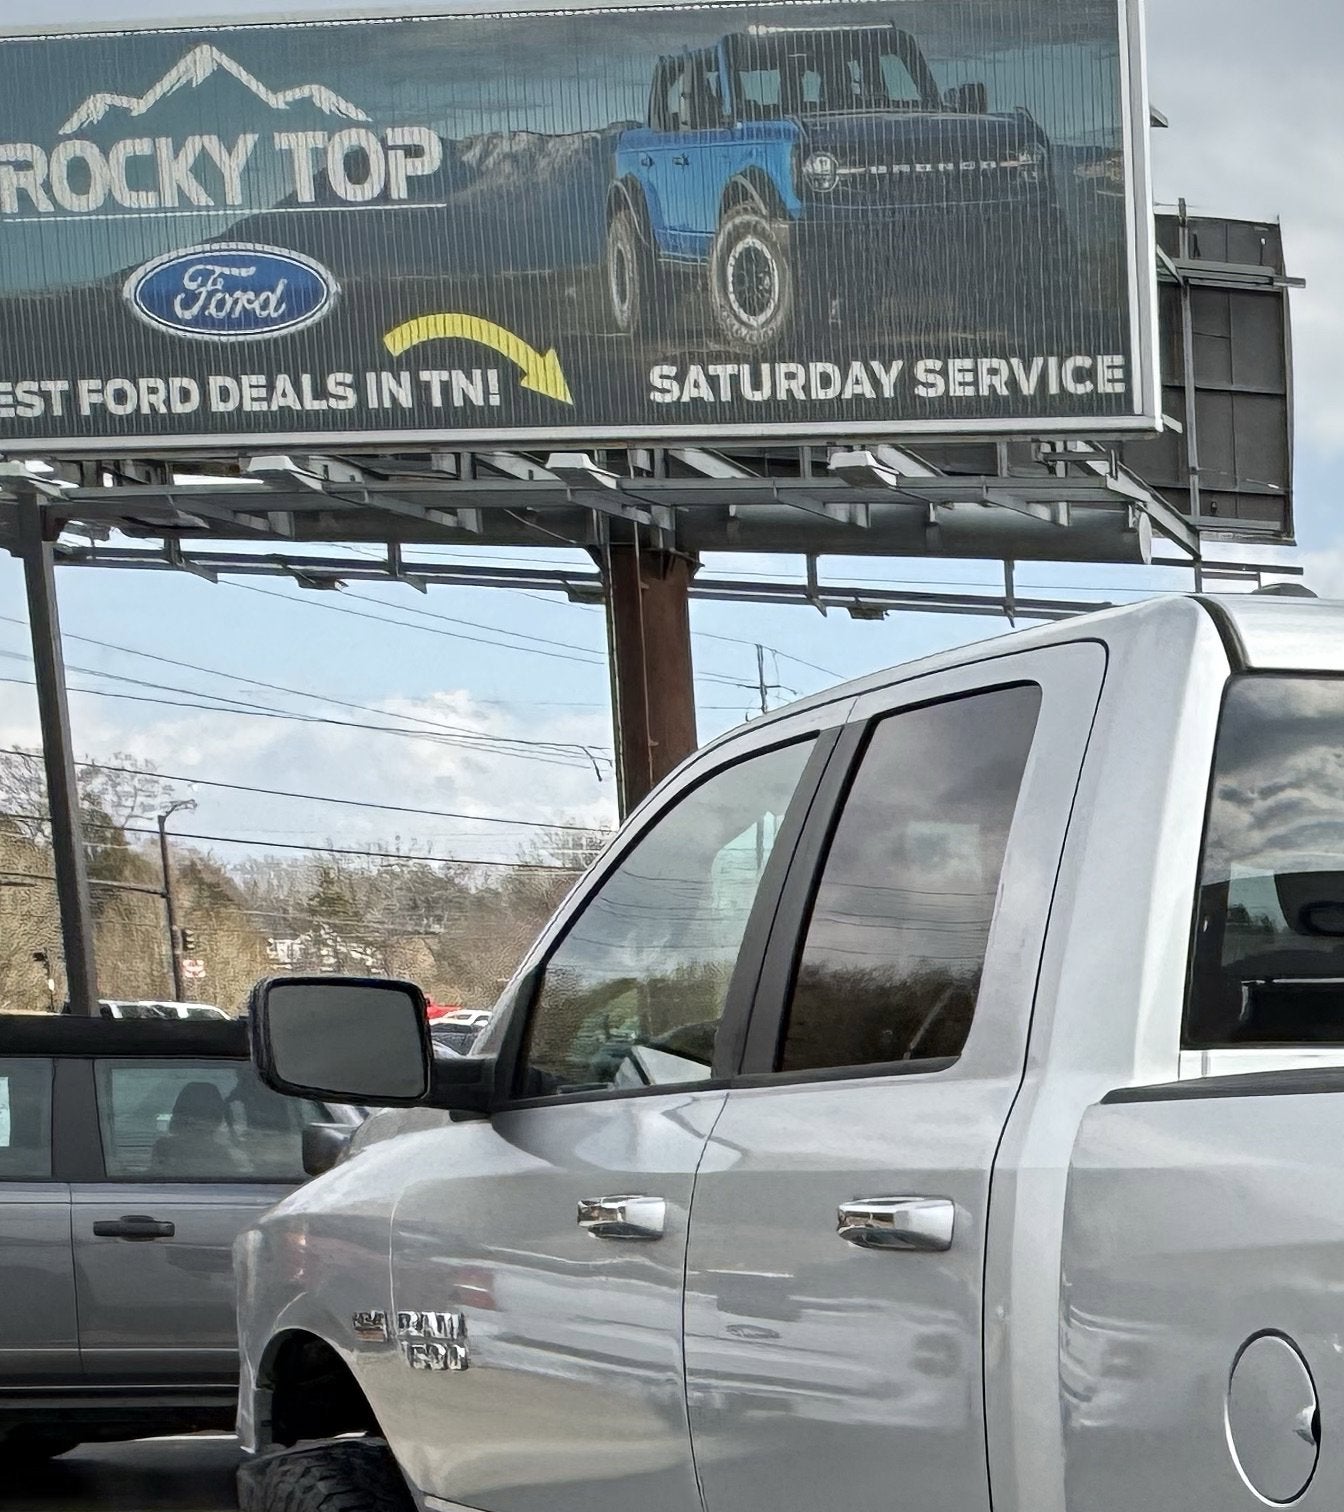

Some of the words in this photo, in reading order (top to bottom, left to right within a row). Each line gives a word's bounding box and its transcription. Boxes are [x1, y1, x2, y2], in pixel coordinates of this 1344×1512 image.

[0, 133, 259, 213] ROCKY
[274, 127, 443, 203] TOP
[173, 264, 288, 319] Ford
[78, 377, 200, 416] FORD
[207, 372, 357, 413] DEALS
[366, 370, 413, 409] IN
[419, 368, 500, 408] TN!
[649, 359, 904, 403] SATURDAY
[914, 355, 1127, 397] SERVICE
